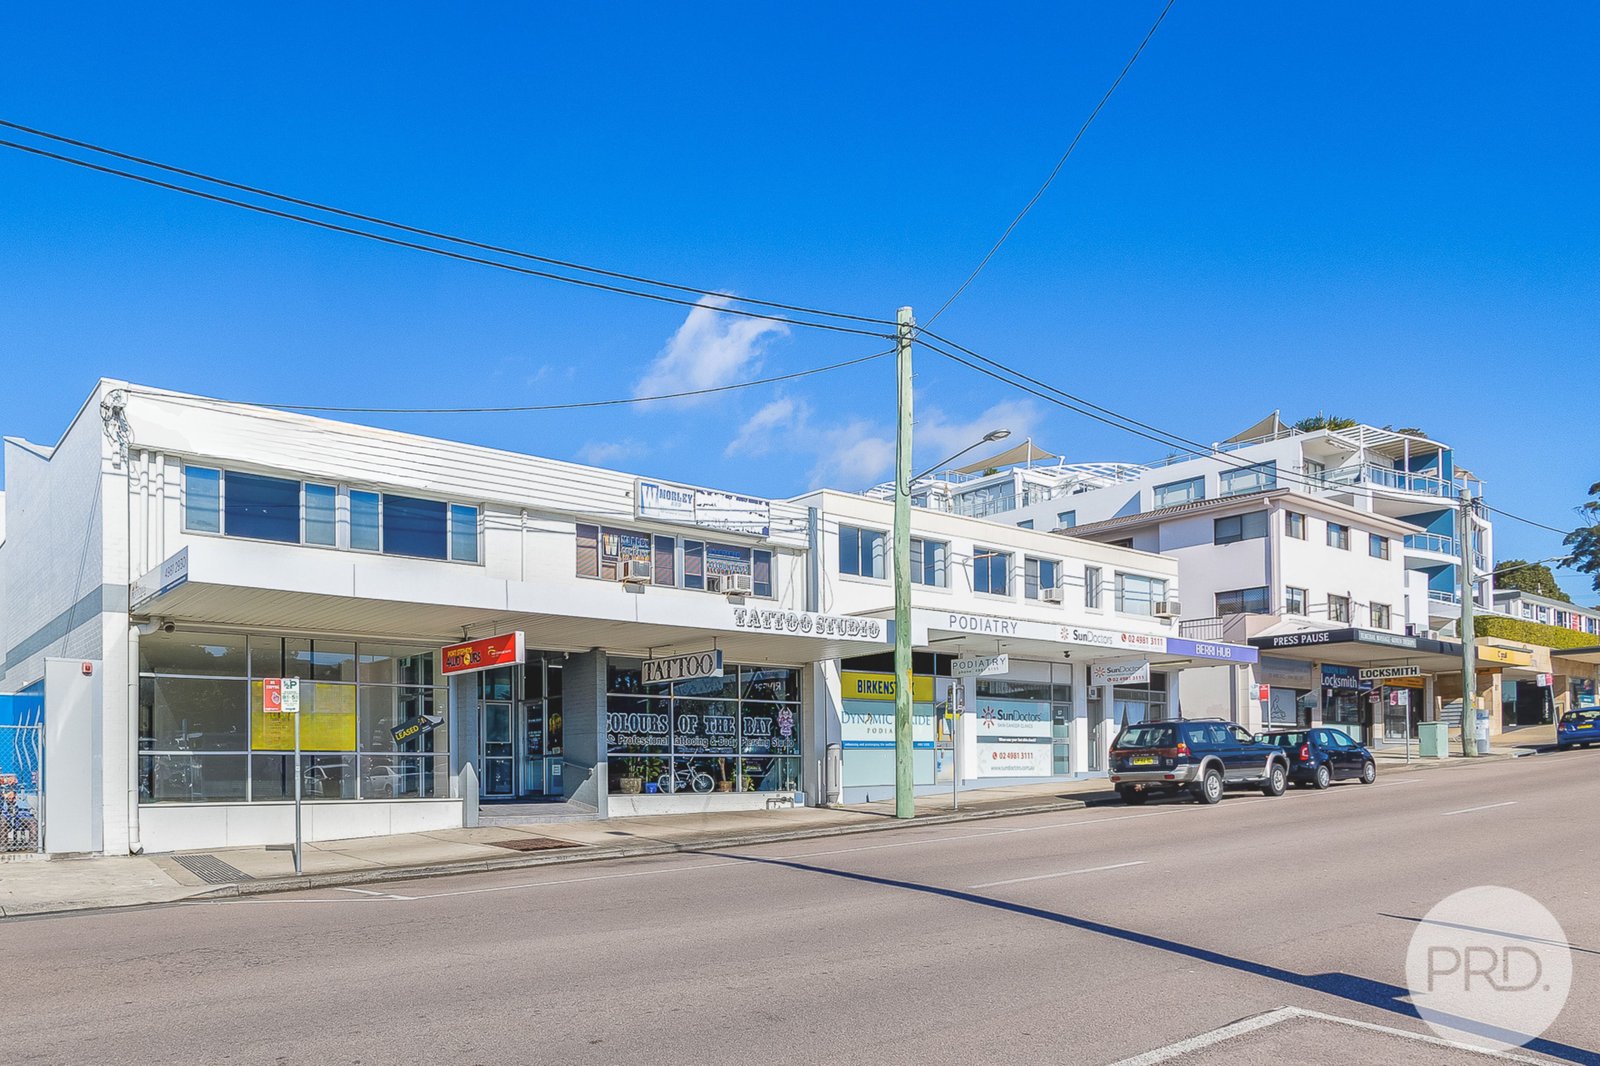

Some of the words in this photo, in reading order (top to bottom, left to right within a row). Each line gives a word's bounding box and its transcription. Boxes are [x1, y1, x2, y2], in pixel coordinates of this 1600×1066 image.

[660, 489, 693, 505] MORLEY
[734, 608, 813, 633] TATTOO
[816, 615, 880, 639] STUDIO
[949, 615, 1018, 634] PODIATRY
[1073, 629, 1113, 645] SunDoctors
[1273, 634, 1299, 646] PRESS
[1300, 632, 1330, 644] PAUSE
[1216, 646, 1231, 658] HUB
[643, 653, 714, 682] TATTOO
[952, 657, 1006, 670] PODIATRY
[1360, 666, 1418, 679] LOCKSMITH
[857, 679, 915, 696] BIRKENS
[1320, 673, 1358, 689] Locksmith
[997, 708, 1041, 722] SunDoctors
[395, 725, 419, 740] LEASED
[678, 714, 699, 734] OF
[703, 715, 736, 736] THE
[743, 717, 772, 736] BAY
[867, 727, 893, 735] PODIA
[617, 734, 670, 746] Professional
[741, 736, 770, 748] Piercing
[1020, 752, 1034, 760] 3111
